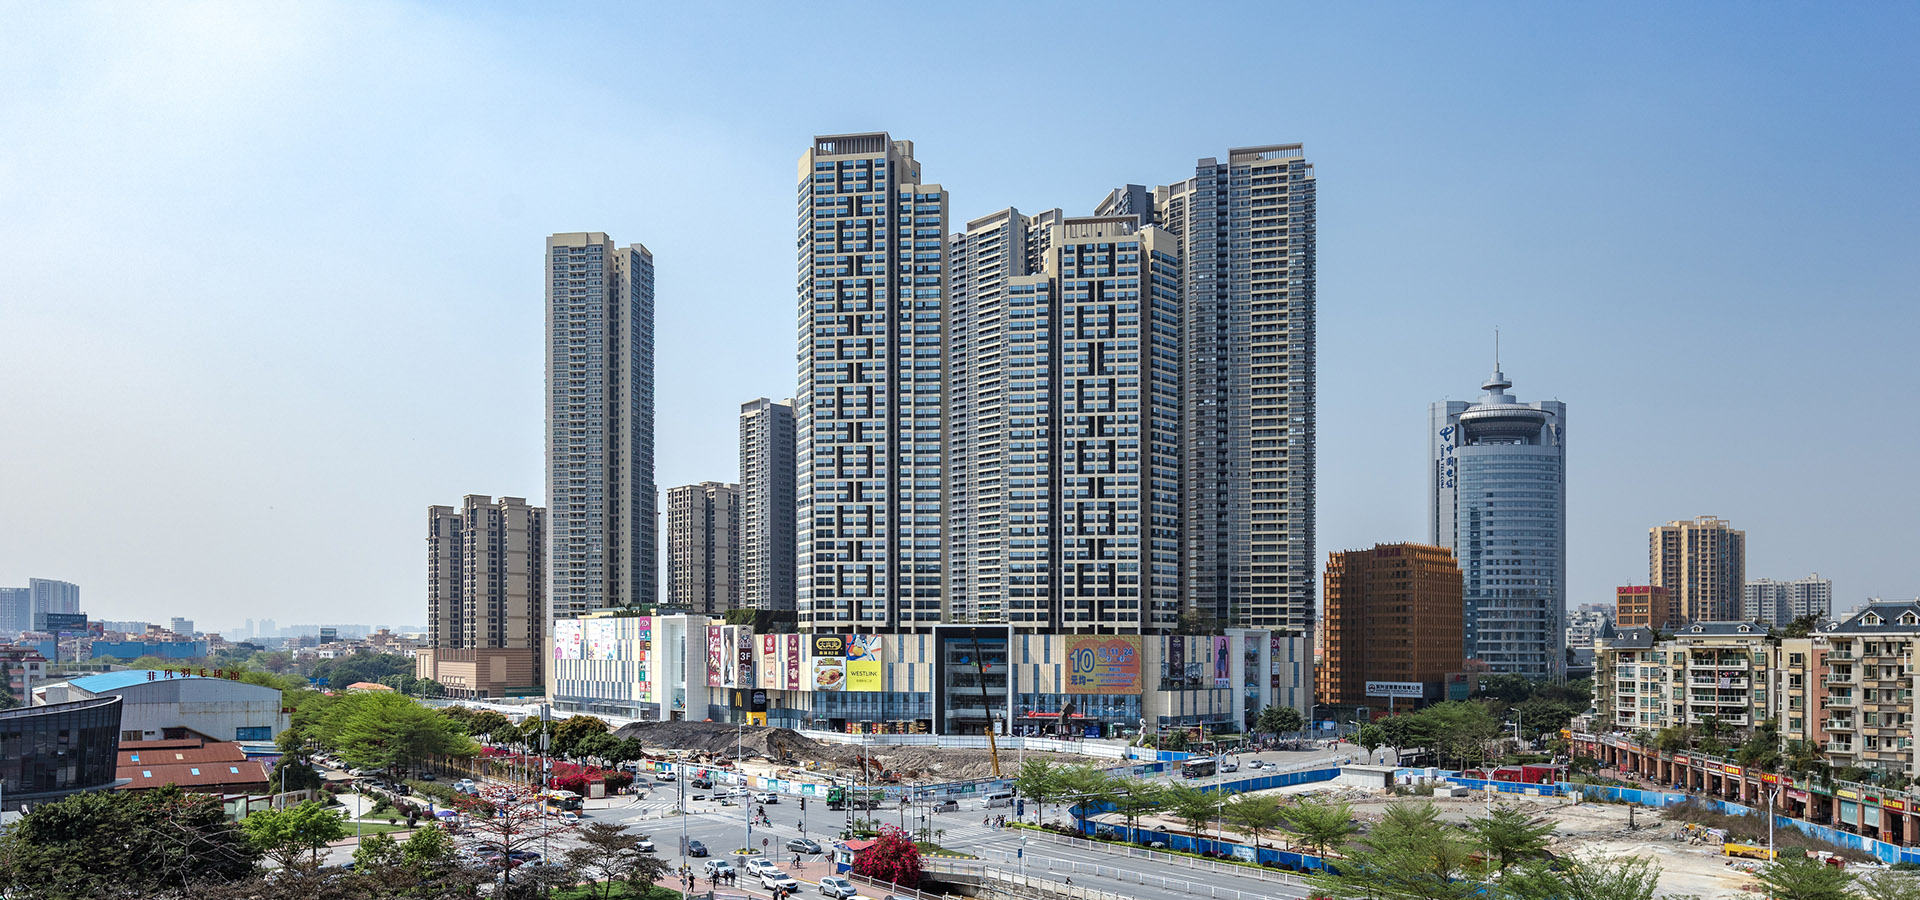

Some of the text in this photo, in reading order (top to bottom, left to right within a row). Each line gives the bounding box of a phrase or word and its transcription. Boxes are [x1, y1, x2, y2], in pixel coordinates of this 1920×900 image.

[1446, 444, 1454, 488] 中国电信
[740, 652, 751, 661] 3F
[1123, 648, 1133, 656] 24
[1069, 648, 1095, 673] 10
[146, 668, 240, 681] 非凡羽毛球馆
[1071, 675, 1094, 686] 元均一
